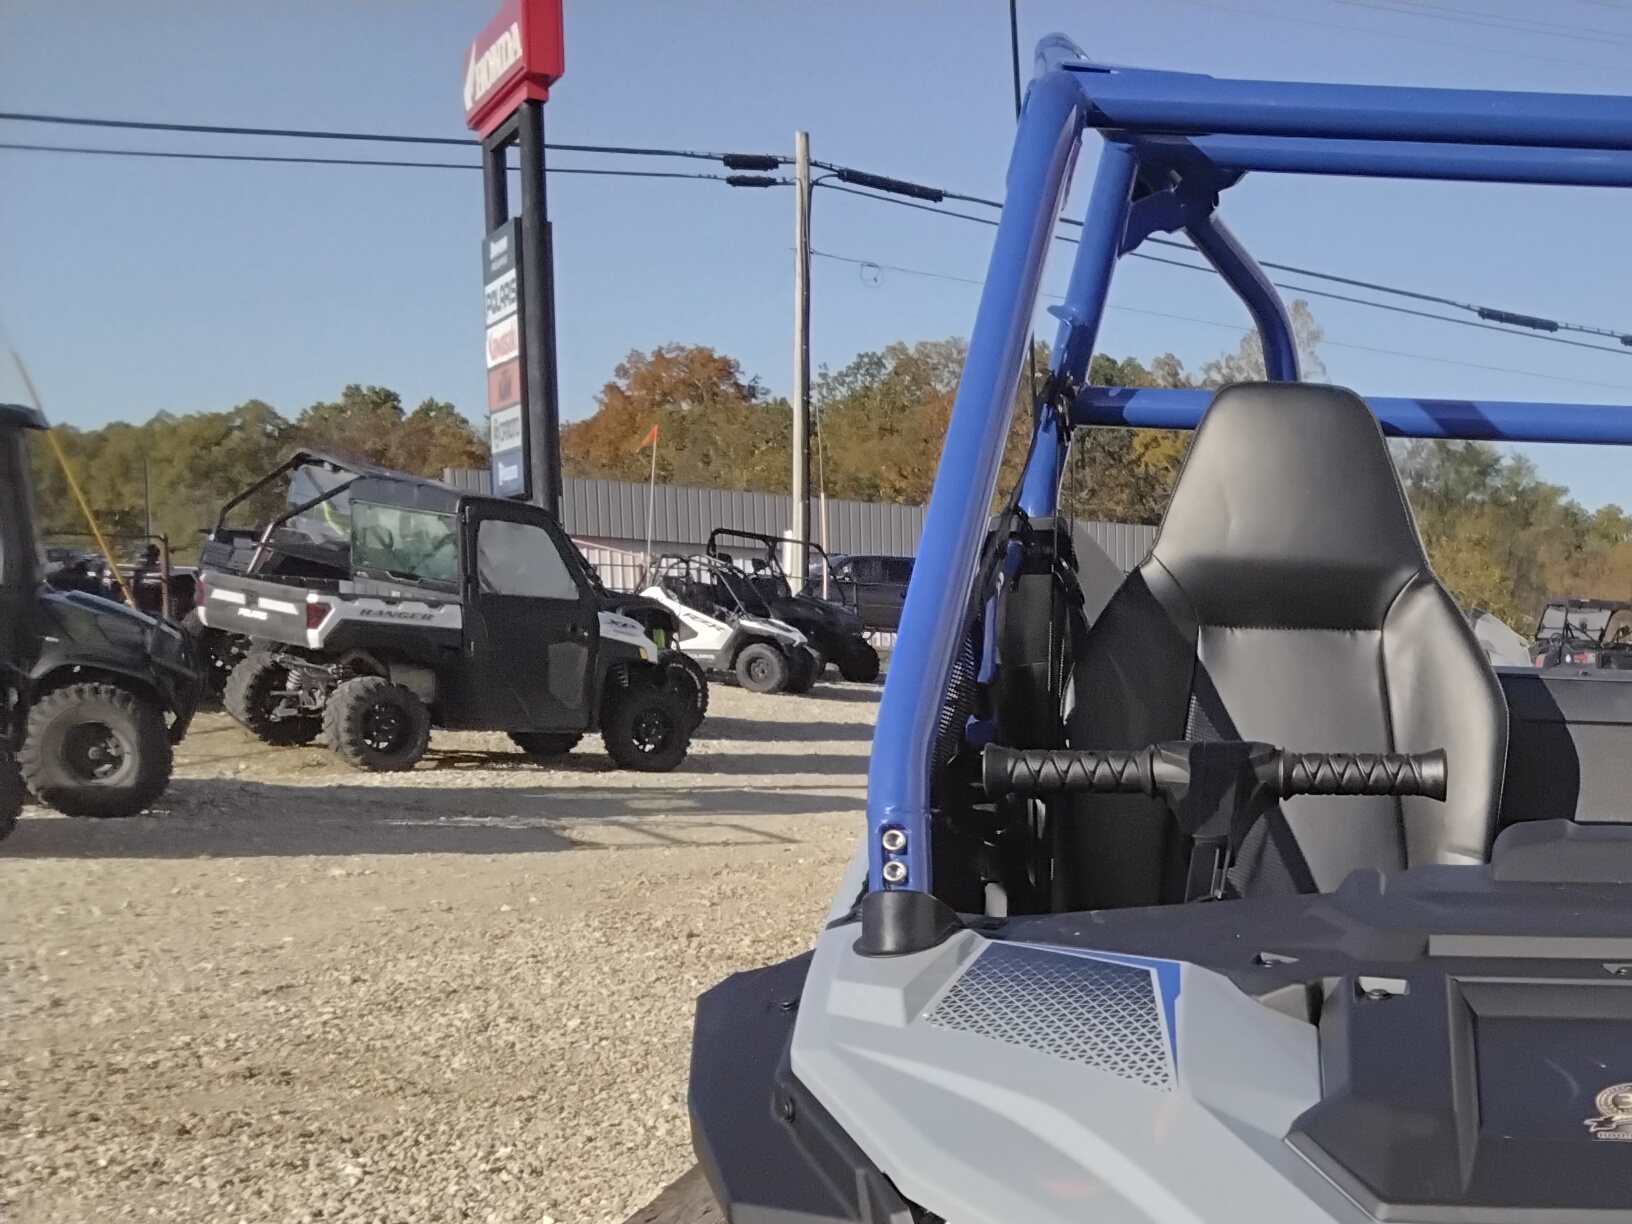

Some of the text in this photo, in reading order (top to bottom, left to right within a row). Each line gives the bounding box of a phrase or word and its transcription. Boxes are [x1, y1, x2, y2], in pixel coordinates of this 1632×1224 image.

[475, 21, 523, 101] HONDA
[486, 276, 516, 315] POLARIS
[358, 608, 435, 621] RANGER
